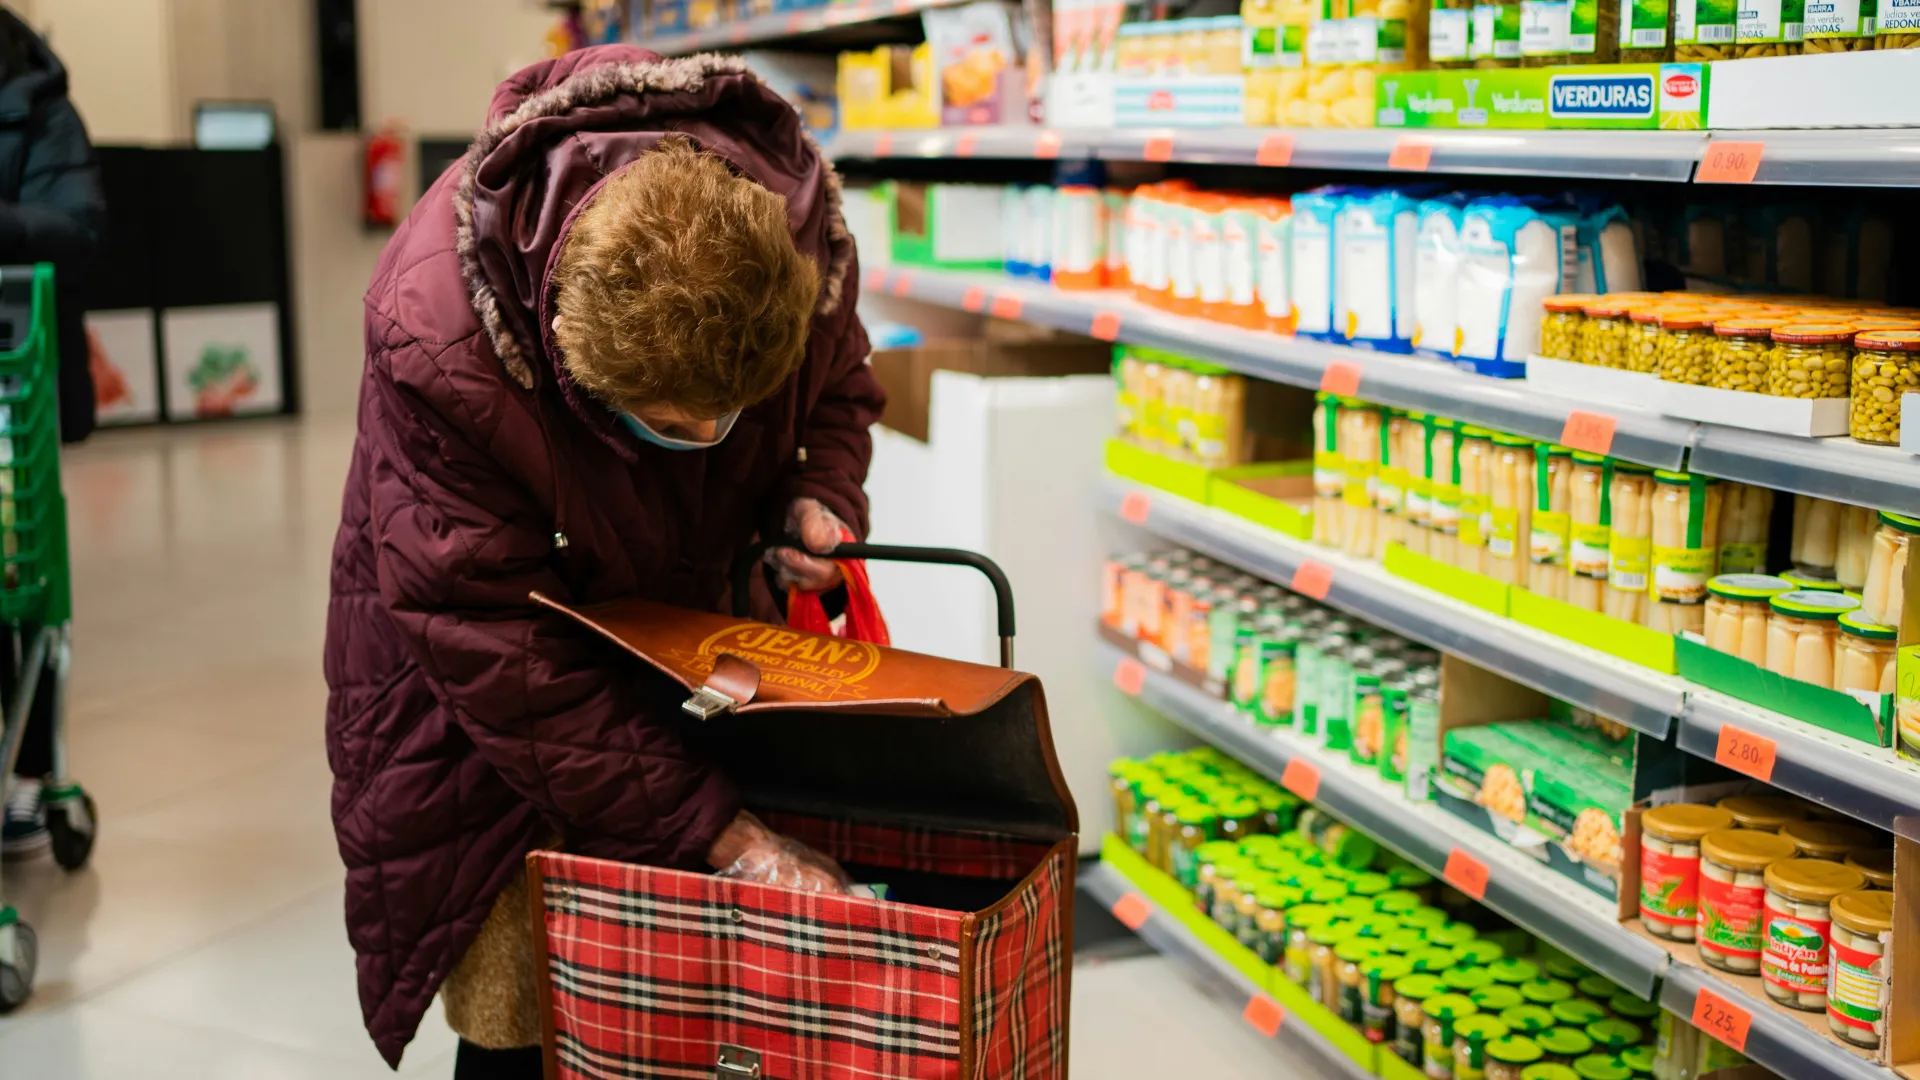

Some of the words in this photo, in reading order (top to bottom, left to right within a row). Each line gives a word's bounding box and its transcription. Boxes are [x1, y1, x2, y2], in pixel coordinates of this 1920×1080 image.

[1818, 14, 1844, 24] verdes
[1491, 89, 1544, 114] Verduras
[1554, 84, 1650, 108] VERDURAS
[738, 627, 857, 665] JEAN
[783, 658, 851, 680] TROLLEY
